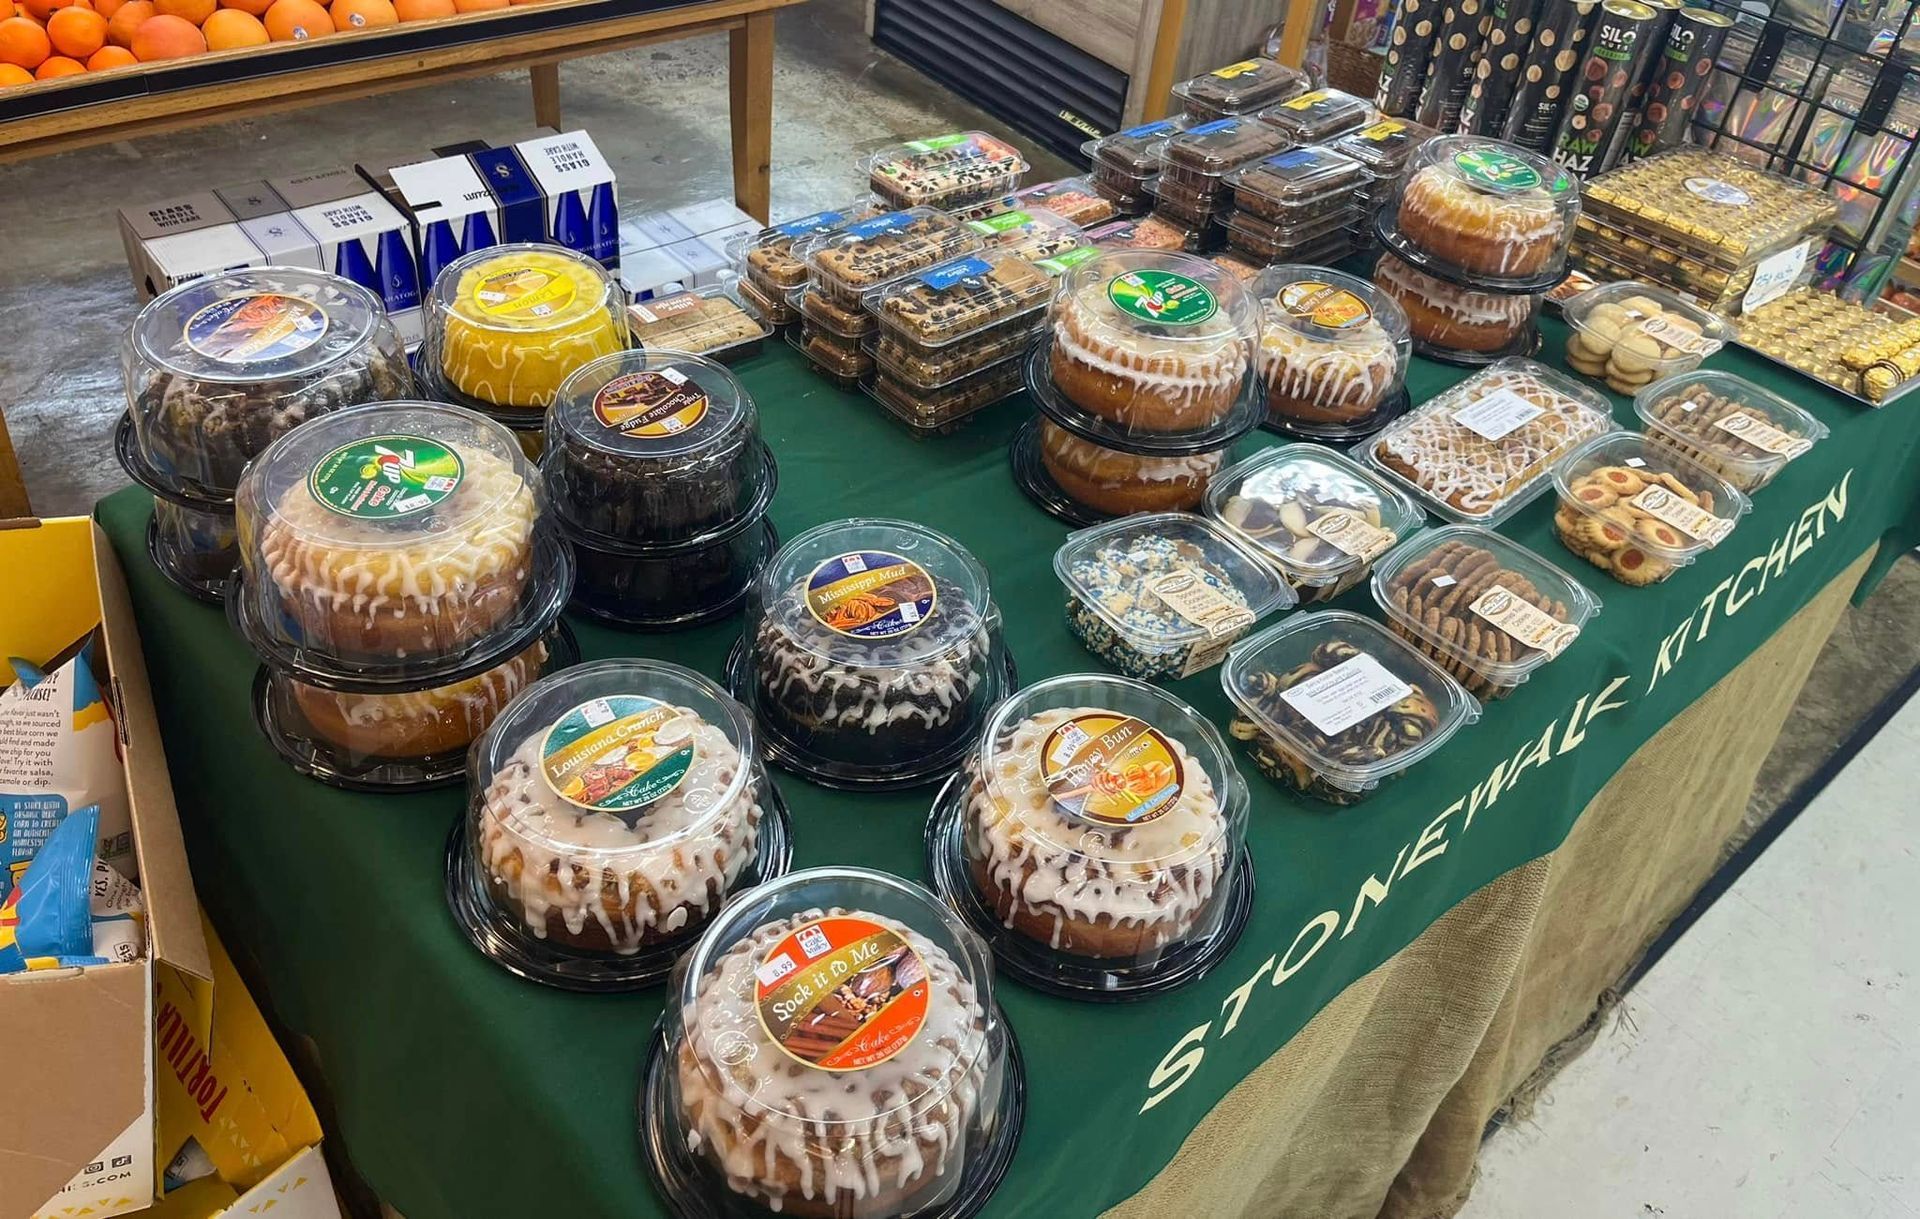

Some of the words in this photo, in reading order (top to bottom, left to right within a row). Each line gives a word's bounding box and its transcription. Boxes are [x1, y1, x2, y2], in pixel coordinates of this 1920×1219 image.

[1600, 25, 1637, 44] SILO
[562, 142, 580, 153] WITH
[1557, 131, 1600, 154] RAW
[543, 146, 564, 157] CARE
[549, 150, 585, 165] HANDLE
[1552, 146, 1595, 172] HAZ
[554, 158, 591, 174] GLASS
[148, 203, 195, 217] GLASS
[153, 210, 197, 223] HANDLE
[328, 209, 369, 223] HANDLE
[157, 219, 181, 229] WITH
[332, 214, 375, 229] GLASS
[513, 289, 554, 309] Lemon
[649, 393, 687, 419] Chocolate
[619, 415, 650, 432] Fudge
[817, 576, 877, 606] Mississippi
[880, 567, 906, 582] Mud
[32, 719, 61, 728] sourced
[33, 739, 56, 747] made
[550, 734, 615, 778] Louisiana
[615, 710, 665, 738] Crunch
[24, 748, 34, 756] for
[35, 751, 52, 759] you
[1064, 747, 1105, 788] Honey
[1101, 725, 1133, 751] Bun
[14, 758, 25, 769] Try
[26, 758, 32, 766] it
[34, 758, 54, 767] with
[30, 769, 55, 778] salsa,
[34, 778, 52, 788] dip.
[1138, 674, 1633, 1116] STONEWALL
[1644, 467, 1855, 697] KITCHEN
[772, 985, 814, 1022] Sock
[813, 973, 829, 989] it
[848, 943, 880, 967] Me
